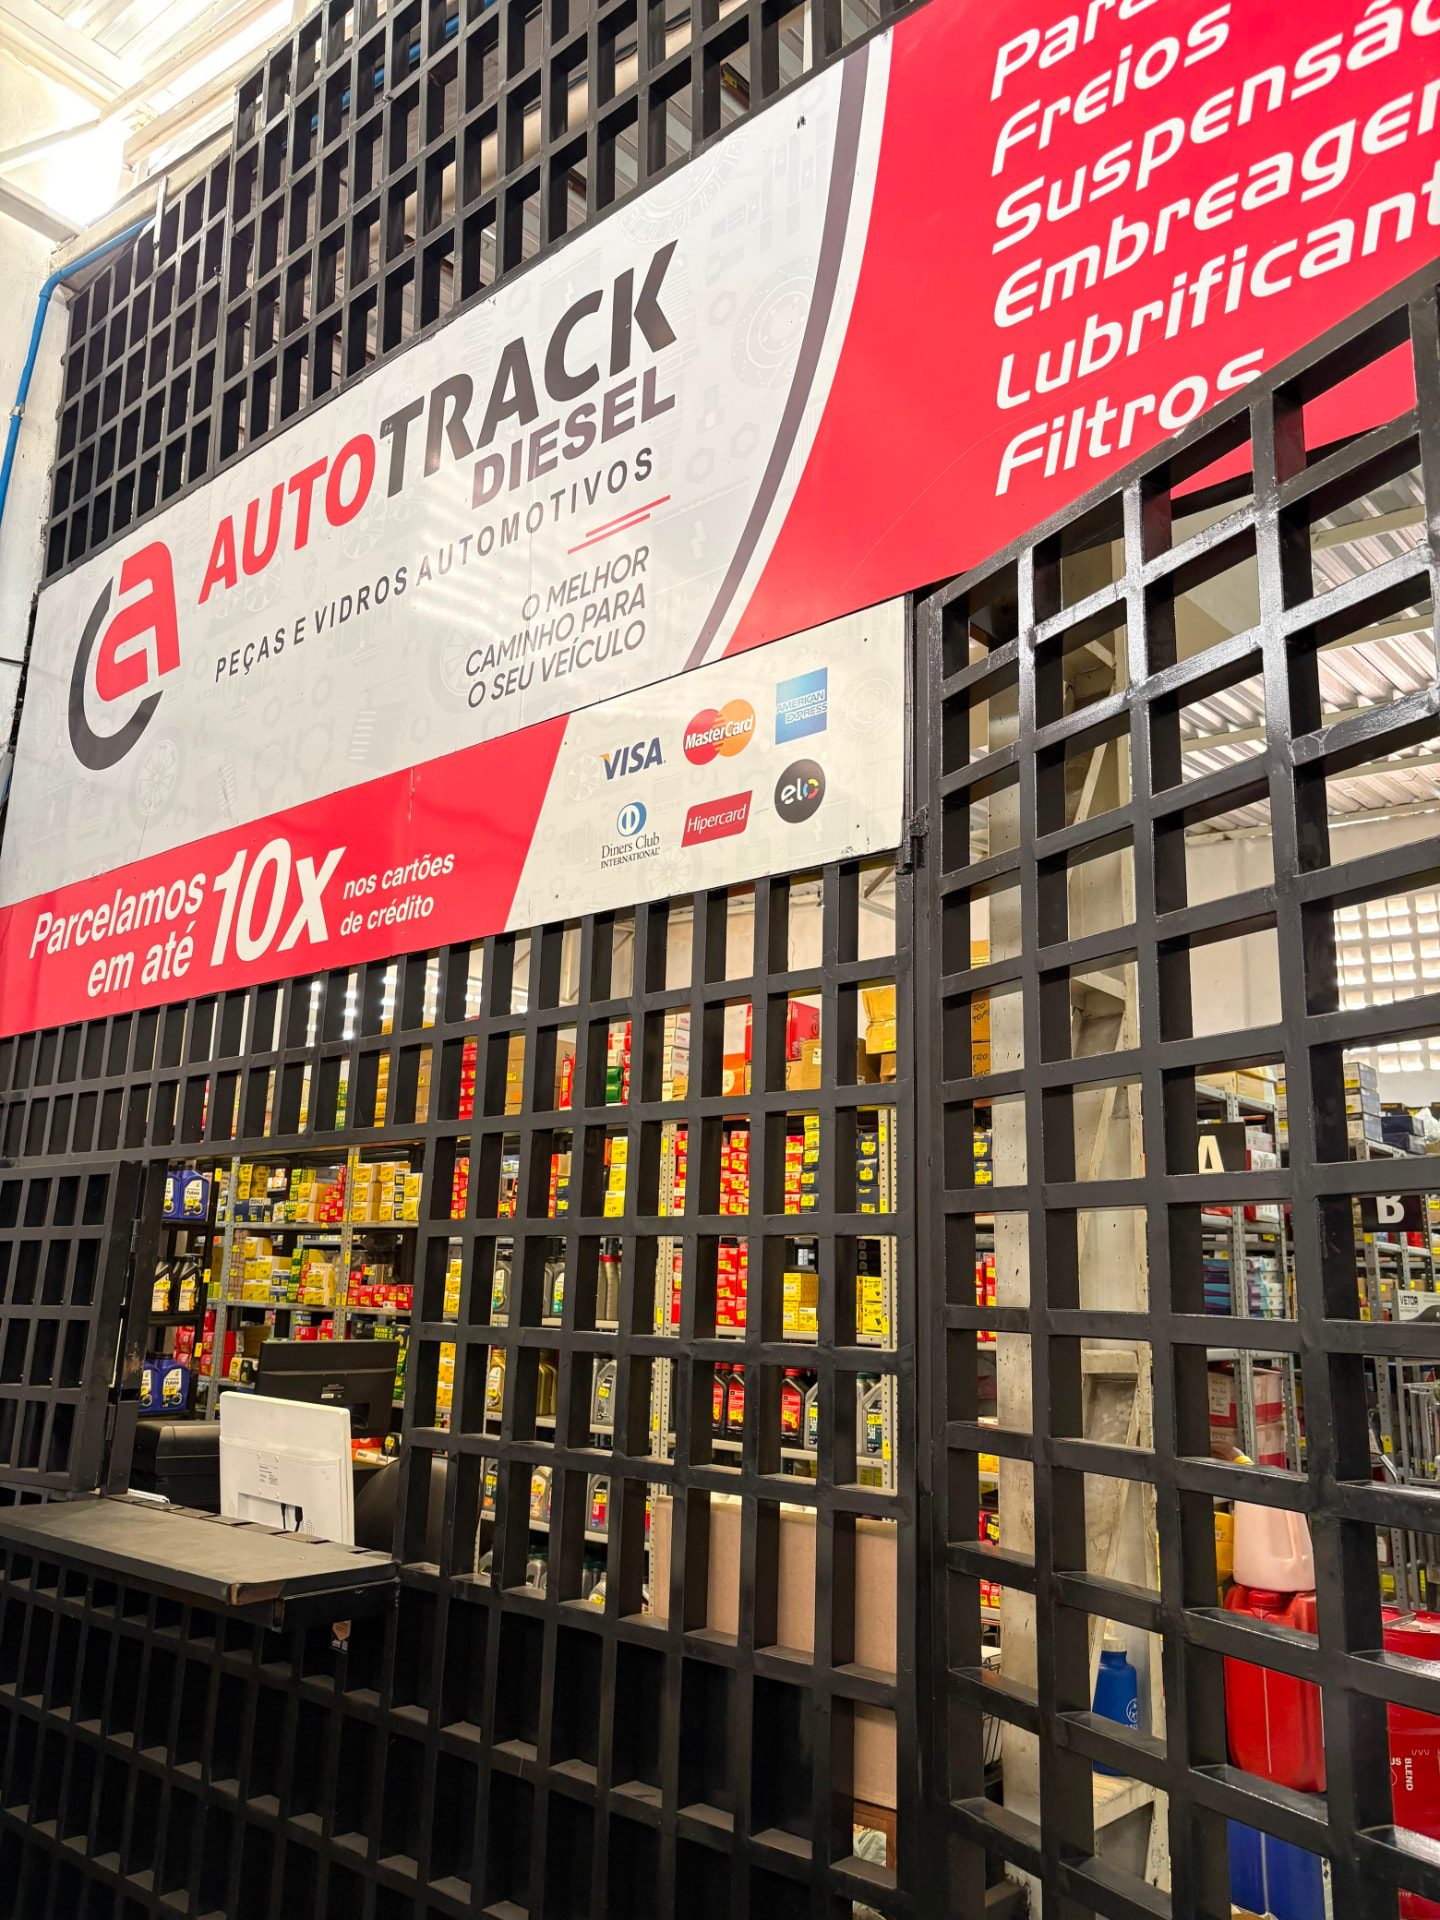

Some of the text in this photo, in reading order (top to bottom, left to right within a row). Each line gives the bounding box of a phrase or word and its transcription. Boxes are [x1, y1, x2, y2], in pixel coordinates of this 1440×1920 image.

[991, 3, 1232, 177] Freios
[472, 366, 676, 510] DIESEL
[995, 348, 1264, 497] Filtros
[215, 447, 653, 683] PEÇAS E VIDROS AUTOMOTIVOS
[522, 546, 649, 622] O MELHOR
[465, 583, 646, 677] CAMINHO PARA
[467, 621, 646, 708] O SEU VEÍCULO
[776, 690, 825, 714] AMERICAN
[785, 702, 828, 724] EXPRESS
[684, 713, 755, 751] MasterCard
[599, 737, 663, 780] VISA
[781, 778, 819, 805] elo
[687, 804, 747, 834] Hipercard
[600, 847, 661, 869] INTERNATIONAL
[601, 832, 660, 859] Diners Club
[29, 838, 455, 967] Parcelamos 10x nos cartões
[86, 893, 434, 997] em até de crédito
[1198, 1135, 1225, 1174] A
[1375, 1195, 1405, 1224] B
[1405, 1758, 1413, 1791] BLEND
